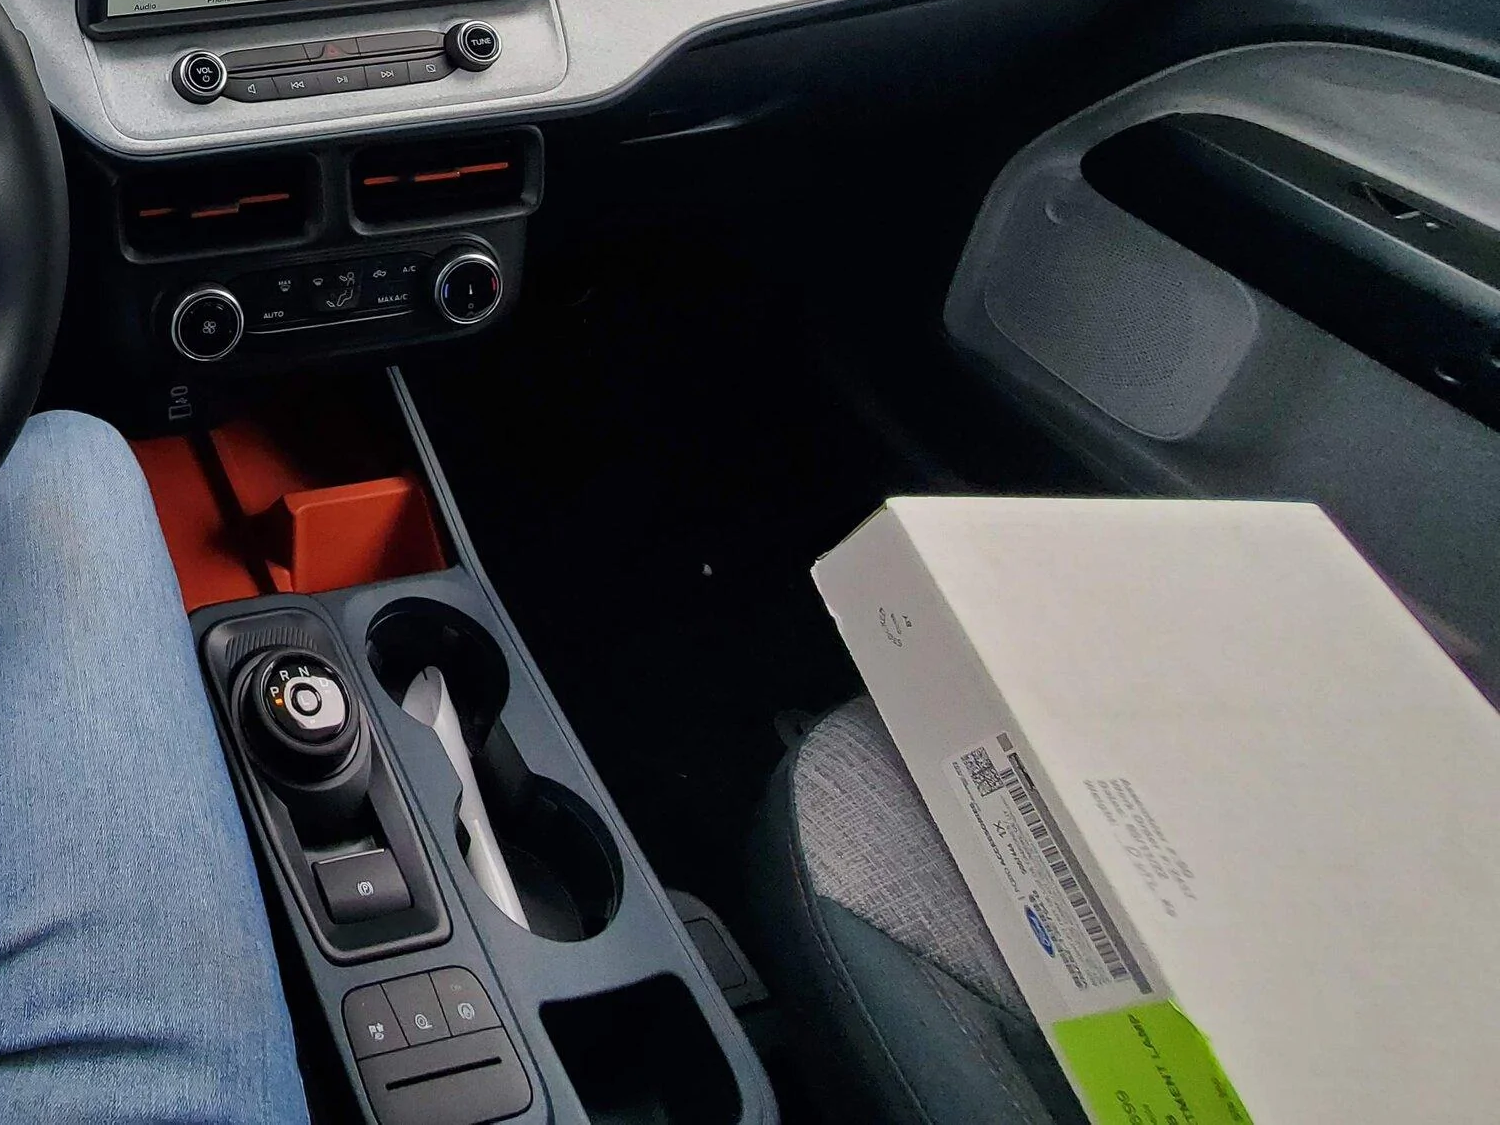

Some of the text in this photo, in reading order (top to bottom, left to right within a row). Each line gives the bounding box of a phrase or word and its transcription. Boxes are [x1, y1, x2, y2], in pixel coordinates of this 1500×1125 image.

[134, 3, 157, 12] Audio
[470, 36, 493, 46] TUNE
[196, 66, 213, 75] VOL
[402, 265, 417, 273] A/C
[377, 293, 408, 303] MAX A/C
[263, 310, 284, 319] AUTO
[279, 670, 290, 681] R
[298, 665, 310, 677] N
[270, 686, 279, 697] P
